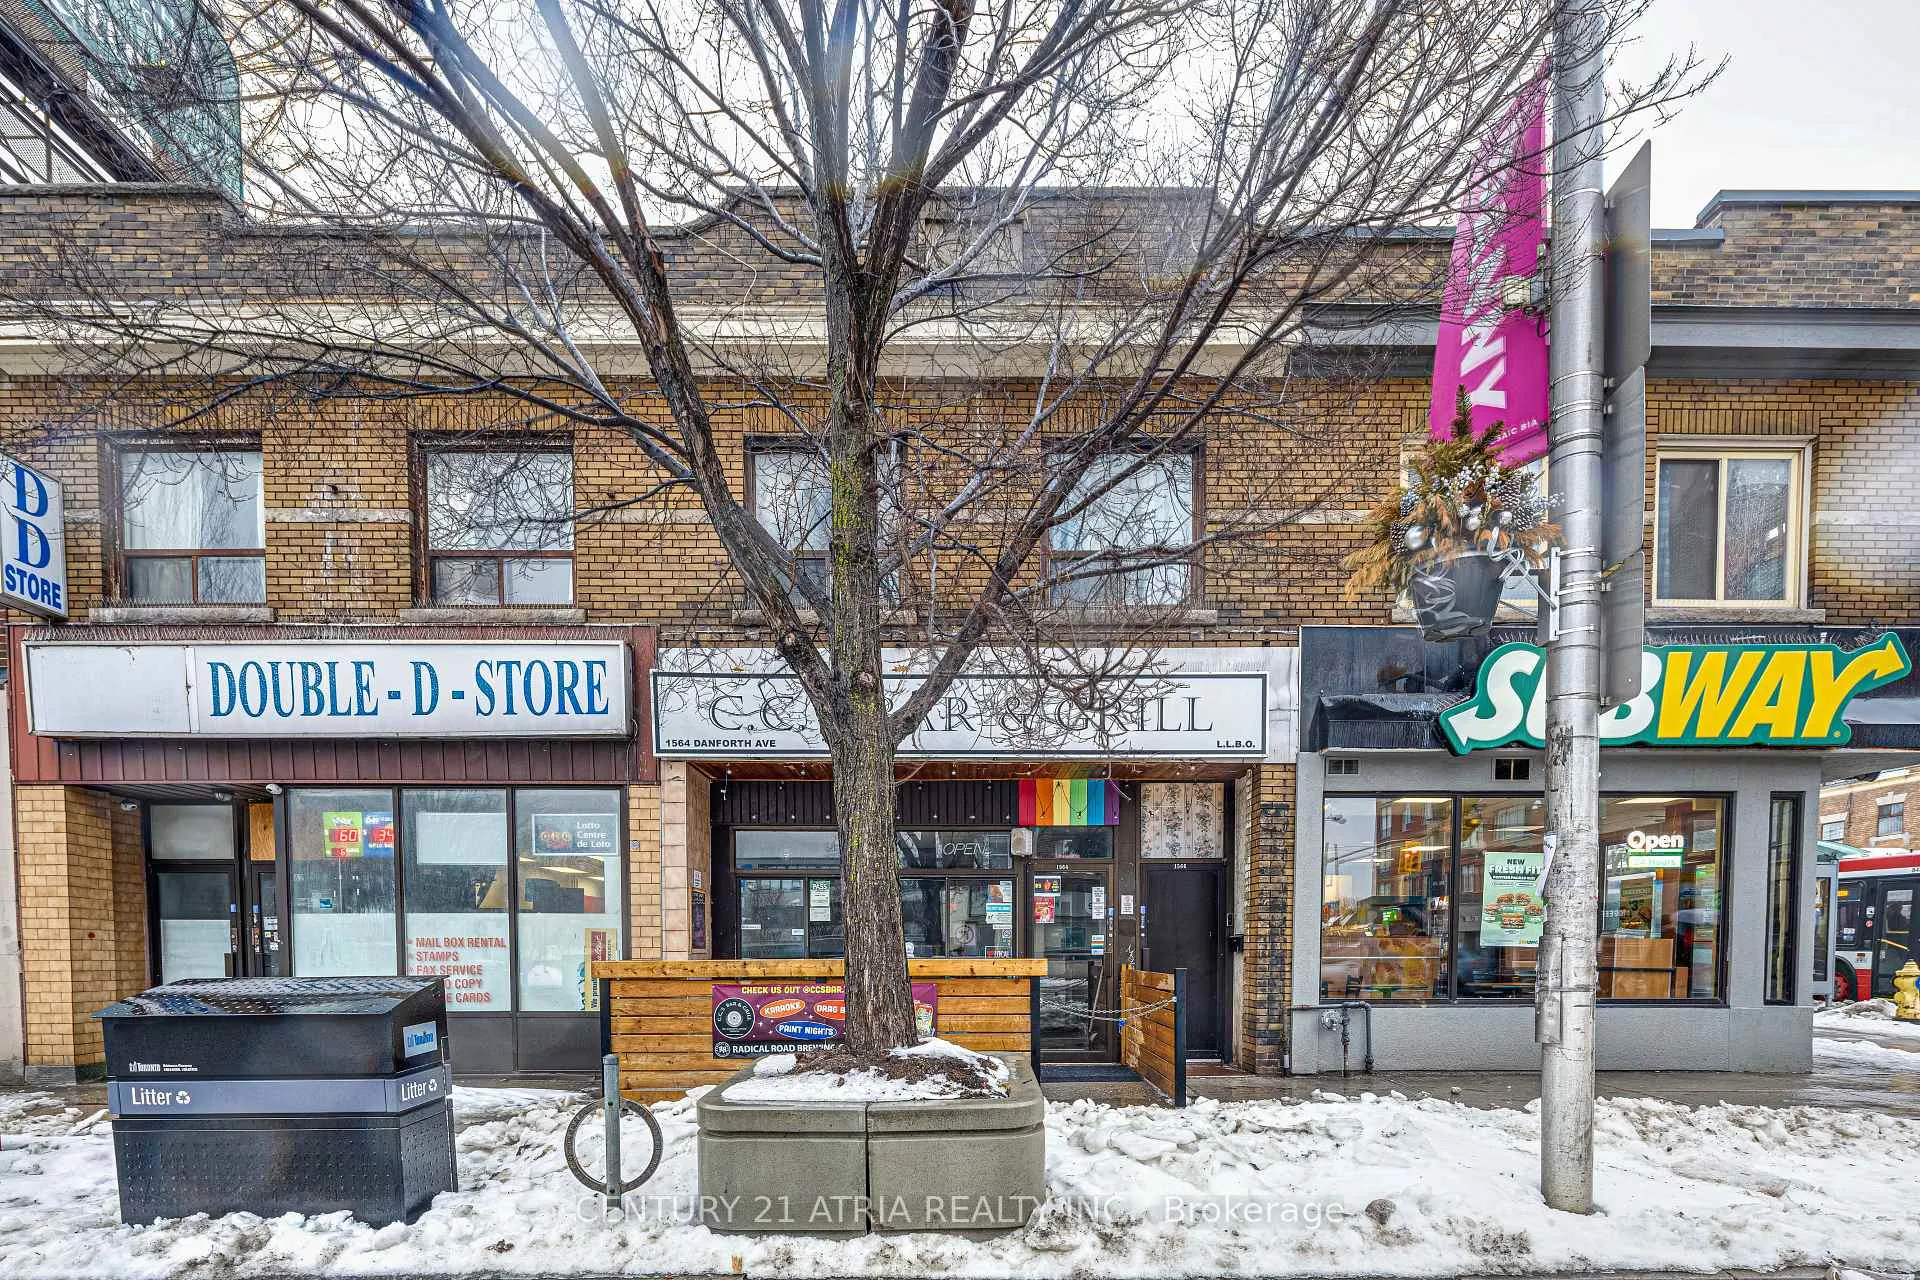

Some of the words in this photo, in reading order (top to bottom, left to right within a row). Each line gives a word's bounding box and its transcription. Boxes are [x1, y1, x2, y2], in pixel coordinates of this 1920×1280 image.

[1520, 419, 1537, 431] BIA
[10, 462, 48, 517] D
[12, 515, 51, 569] D
[5, 564, 62, 609] STORE
[207, 660, 379, 718] DOUBLE
[475, 659, 610, 716] STORE
[1447, 640, 1904, 745] SBWAY
[999, 696, 1033, 731] &
[1054, 696, 1214, 731] GRILL
[666, 739, 690, 748] 1564
[693, 739, 752, 748] DANFORTH
[755, 739, 776, 748] AVE
[1217, 740, 1256, 748] L.L.B.O.
[577, 821, 600, 829] Lotto
[577, 831, 607, 839] Centre
[1627, 831, 1684, 852] Open
[943, 843, 985, 855] OPEN
[416, 937, 442, 948] MAIL
[444, 937, 465, 948] BOX
[467, 937, 507, 949] RENTAL
[416, 951, 459, 962] STAMPS
[417, 965, 436, 975] FAX
[440, 964, 483, 976] SERVICE
[455, 978, 482, 989] COPY
[742, 986, 769, 994] CHECK
[771, 986, 782, 994] US
[784, 986, 800, 994] OUT
[803, 986, 845, 994] @CCSBAR.
[456, 992, 491, 1003] CARDS
[764, 1002, 801, 1015] KARAOKE
[816, 1004, 838, 1013] DRAG
[779, 1025, 803, 1034] PAINT
[805, 1027, 834, 1036] NIGHTS
[732, 1045, 769, 1053] RADICAL
[771, 1044, 796, 1052] ROAD
[797, 1043, 835, 1052] BRENG
[132, 1087, 172, 1105] Litter
[402, 1082, 427, 1102] Litter
